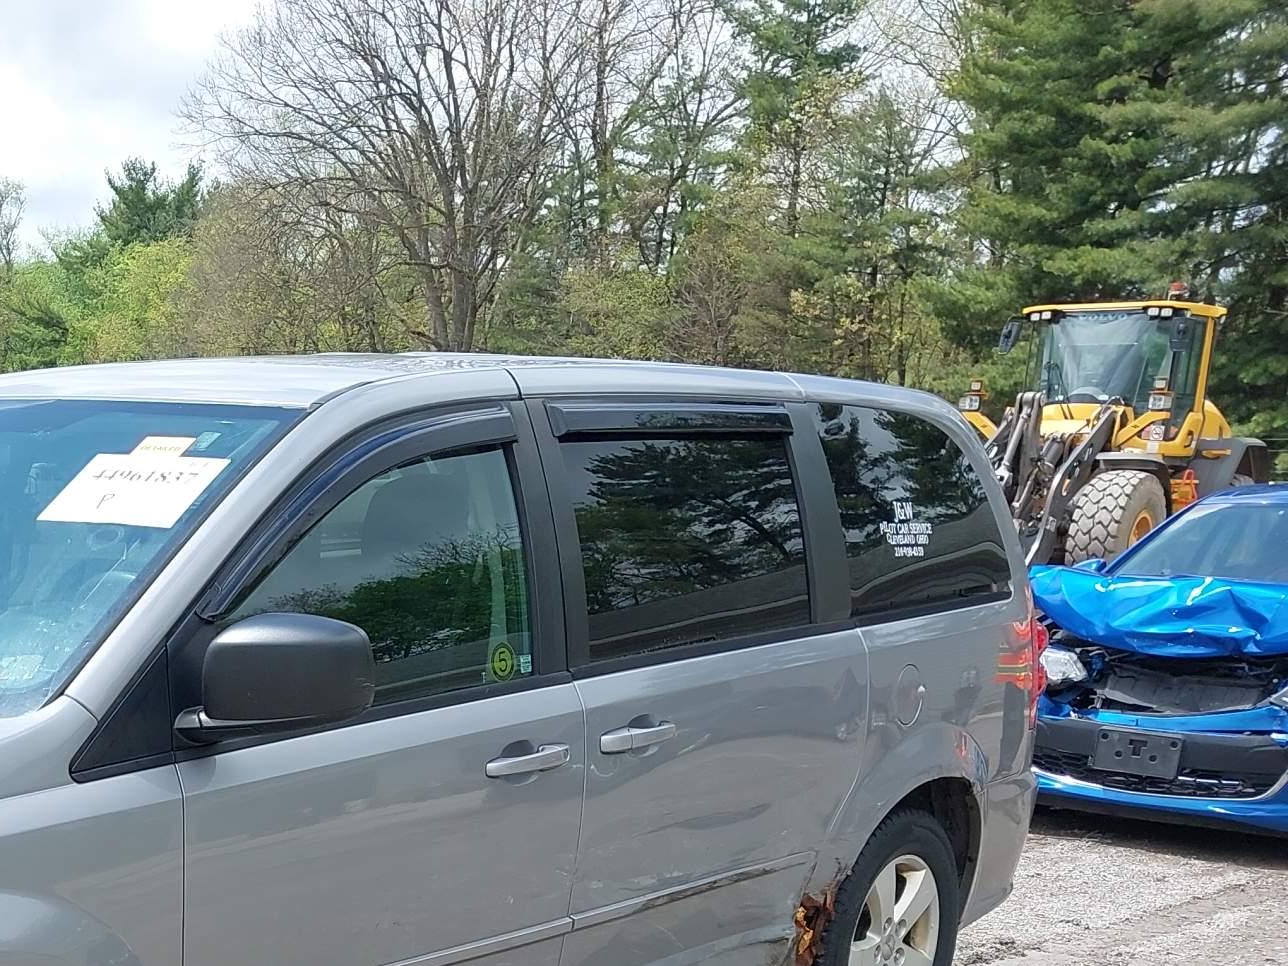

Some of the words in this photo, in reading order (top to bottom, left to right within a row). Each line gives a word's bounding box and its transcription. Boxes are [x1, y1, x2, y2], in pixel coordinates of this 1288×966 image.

[1078, 312, 1129, 321] VOLVO
[92, 469, 199, 484] 44961837
[892, 501, 913, 522] J&W
[897, 522, 909, 534] CAR
[909, 522, 933, 534] SERVICE
[886, 533, 915, 545] CLEVELAND
[498, 650, 508, 672] 5
